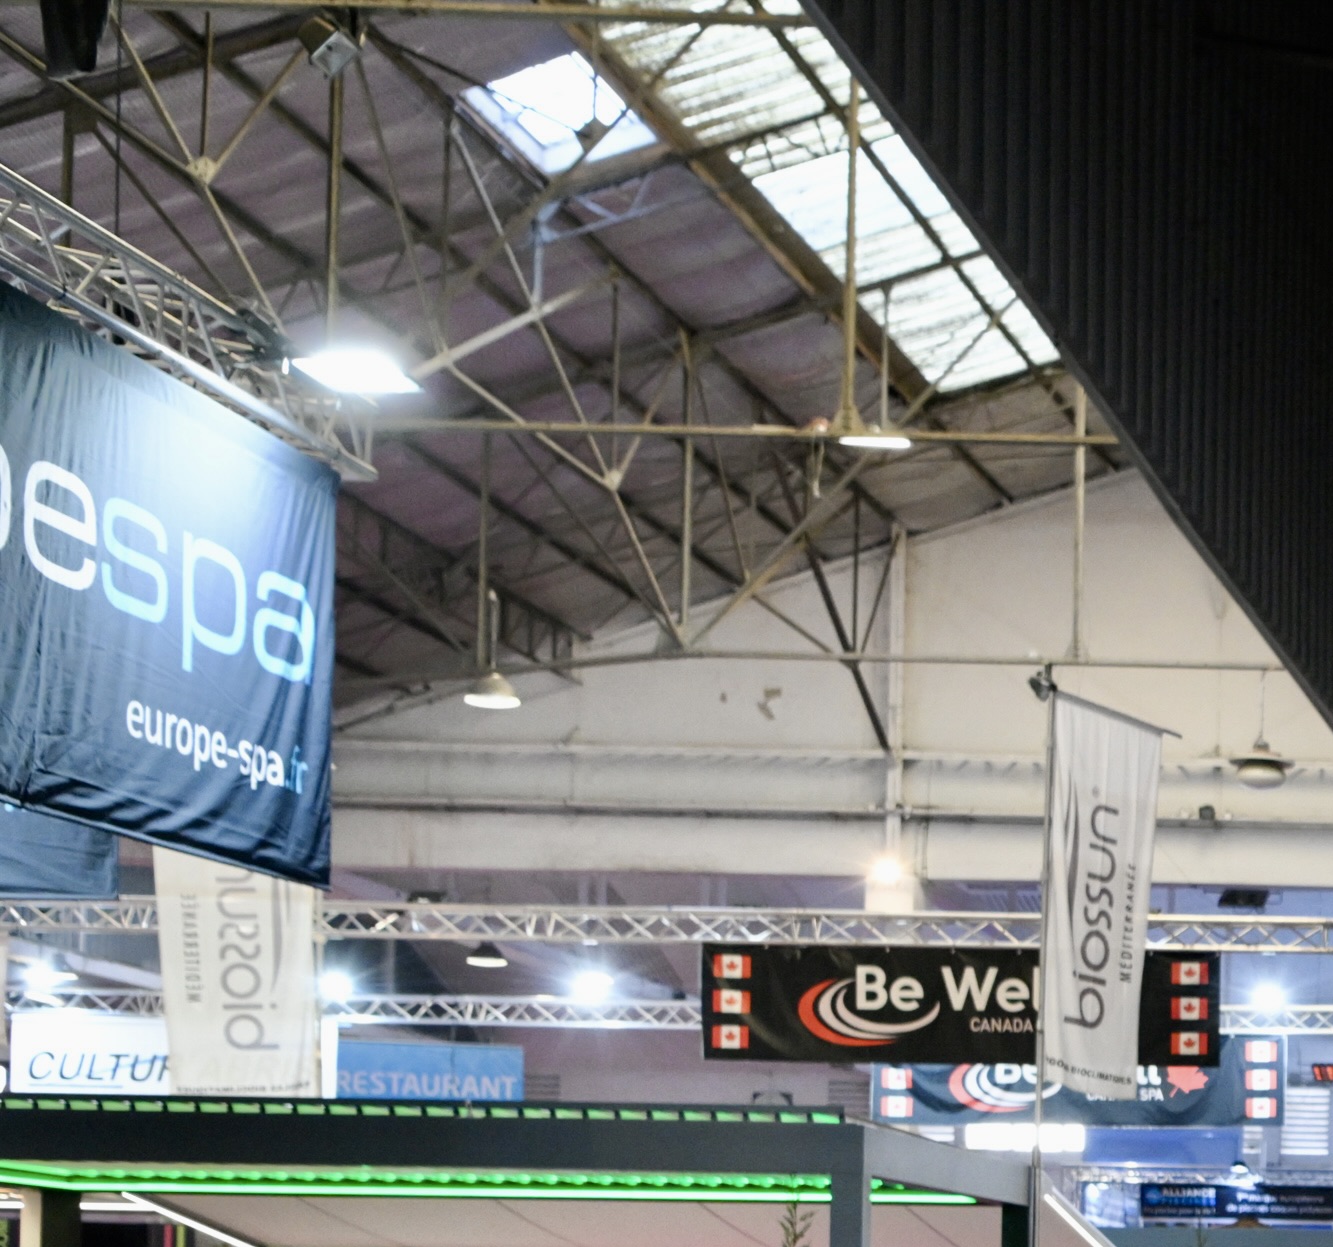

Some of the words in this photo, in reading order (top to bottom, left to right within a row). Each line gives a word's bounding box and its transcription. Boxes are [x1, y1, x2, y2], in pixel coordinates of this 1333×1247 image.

[0, 440, 315, 685] espa
[127, 699, 309, 794] europe-spa.fr
[1063, 804, 1119, 1029] biossun
[855, 964, 925, 1012] Be
[941, 965, 1041, 1013] Wel
[969, 1017, 1034, 1033] CANADA
[337, 1070, 517, 1100] RESTAURANT
[1139, 1088, 1164, 1102] SPA
